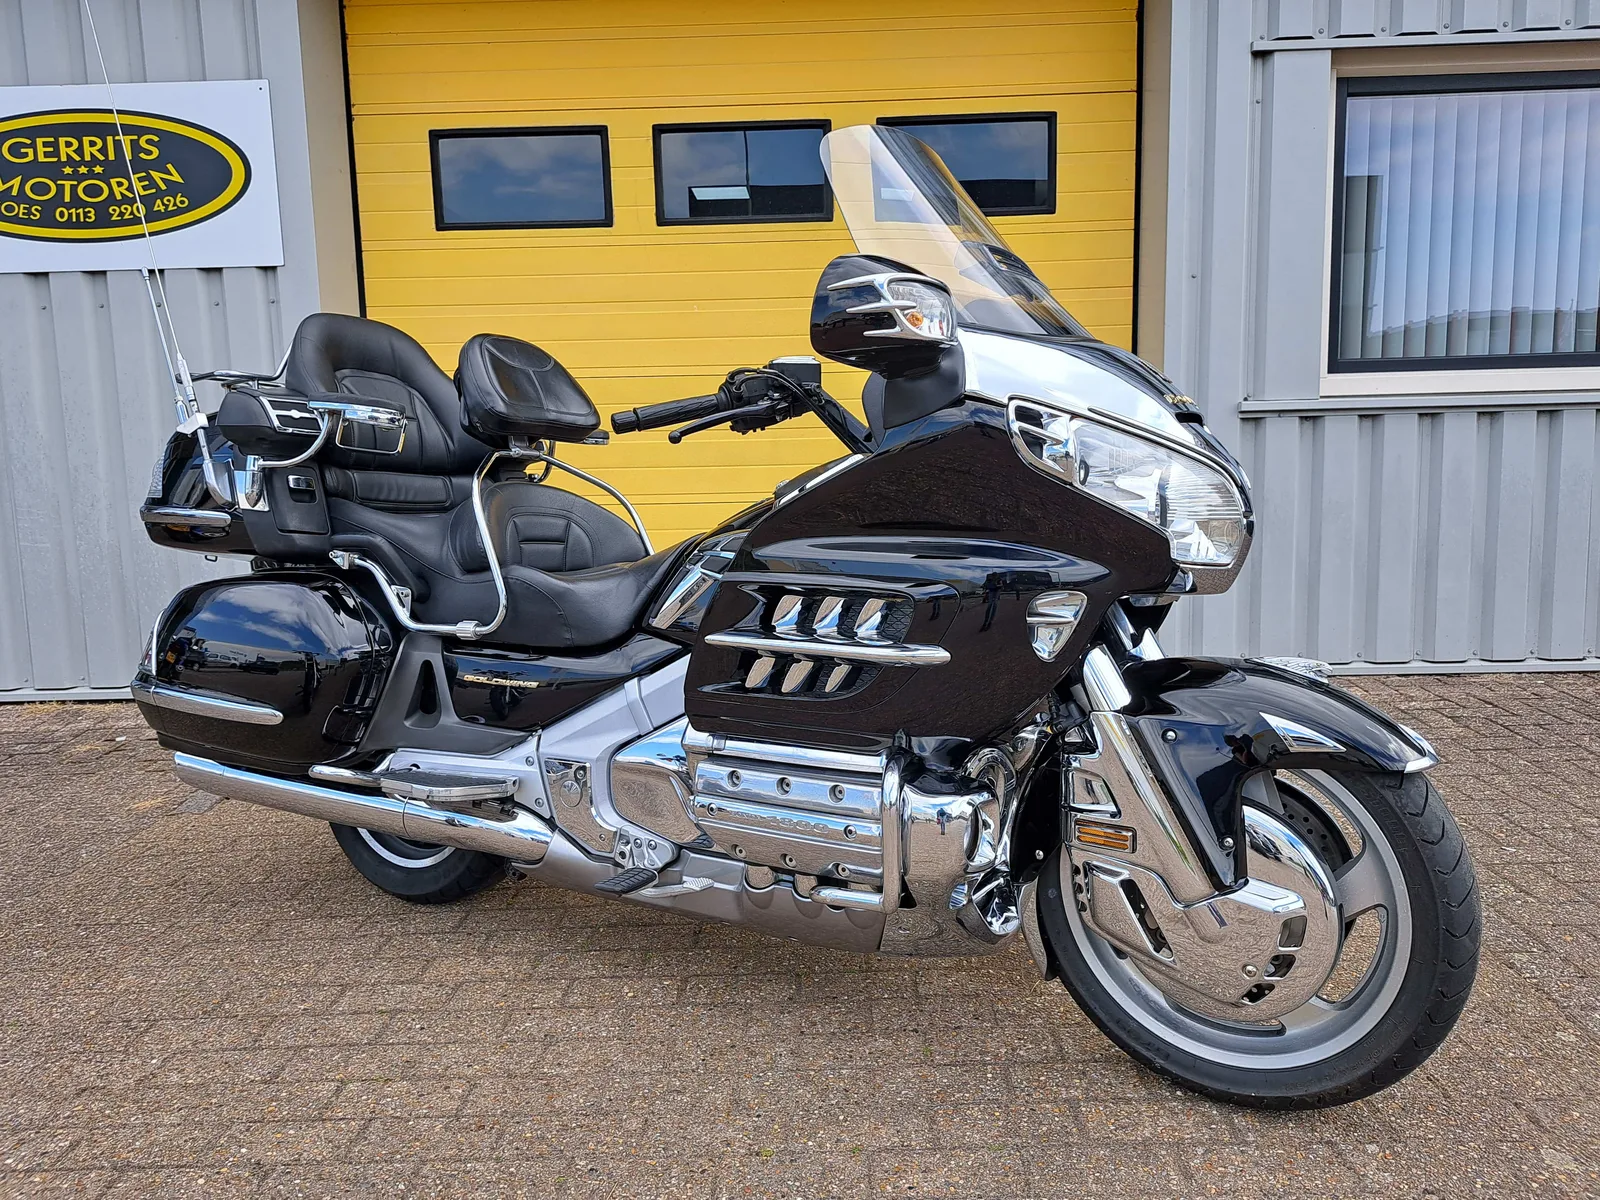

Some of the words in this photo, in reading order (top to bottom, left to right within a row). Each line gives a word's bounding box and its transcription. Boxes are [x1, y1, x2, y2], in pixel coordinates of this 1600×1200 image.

[1, 134, 161, 164] GERRITS
[0, 201, 42, 220] OES
[55, 206, 96, 223] 0113
[108, 203, 147, 221] 220
[153, 192, 189, 213] 426
